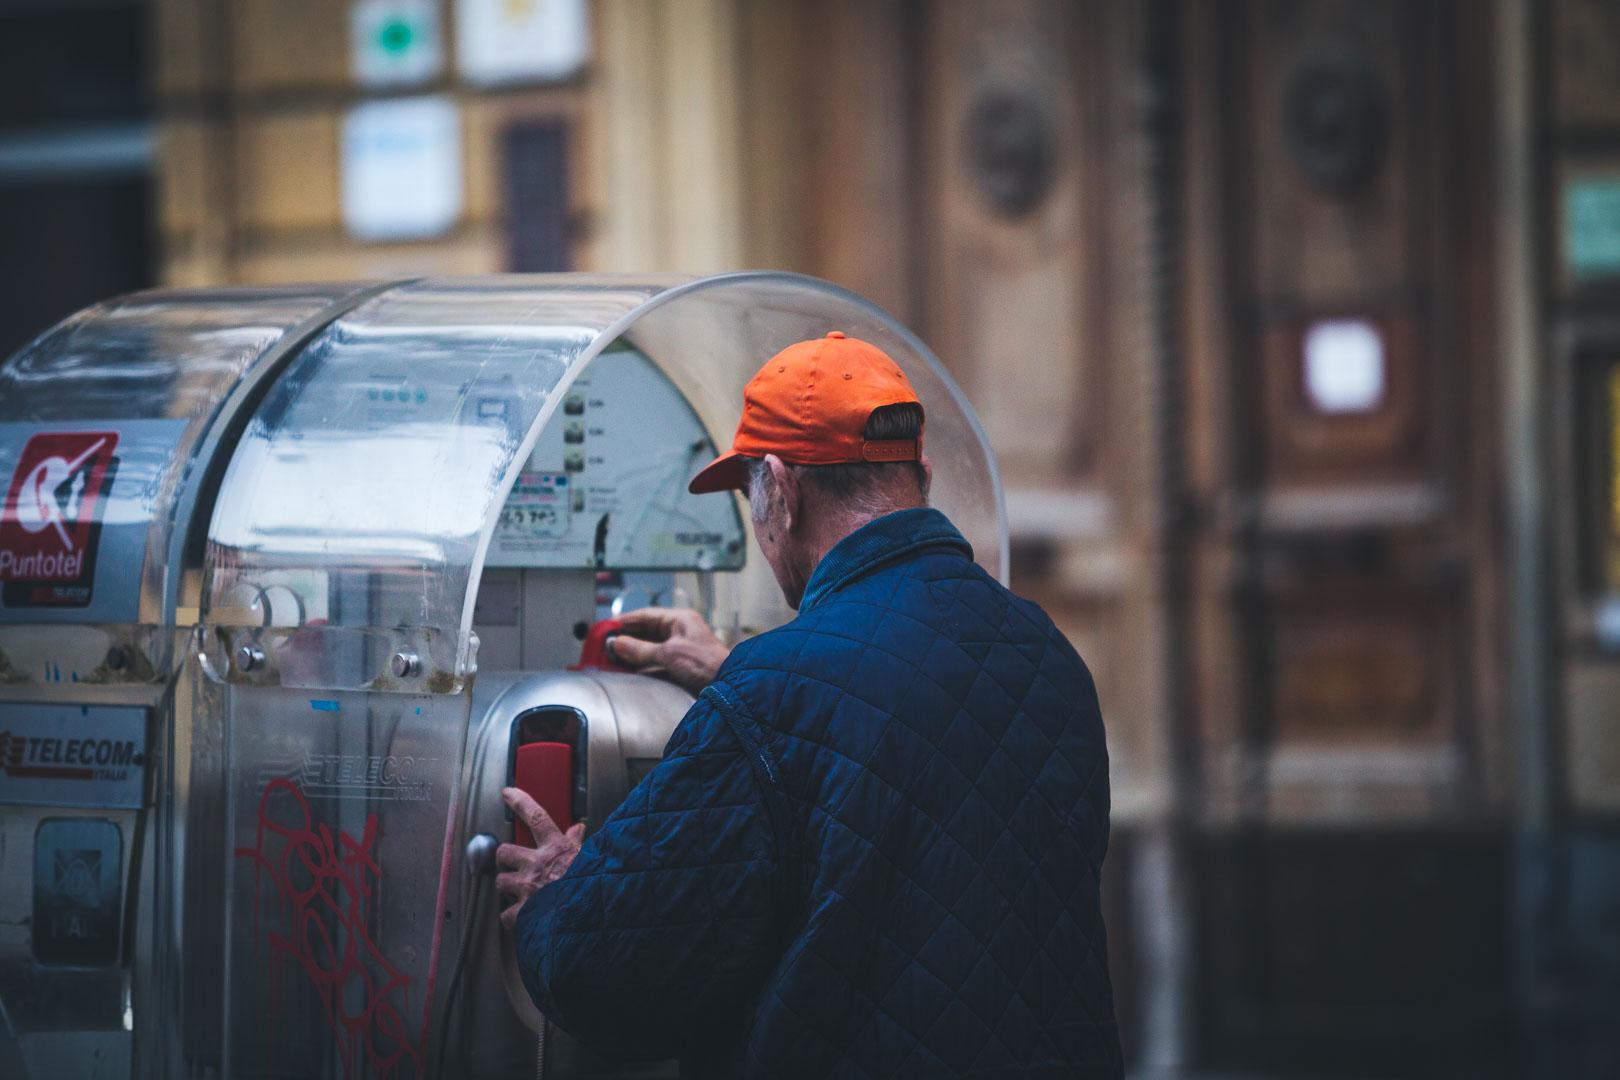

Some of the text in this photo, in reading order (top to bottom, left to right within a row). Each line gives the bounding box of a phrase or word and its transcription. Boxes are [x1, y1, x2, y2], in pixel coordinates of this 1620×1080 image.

[0, 548, 83, 577] Puntotel
[29, 737, 134, 766] TELECOM
[95, 769, 128, 782] ITALIA
